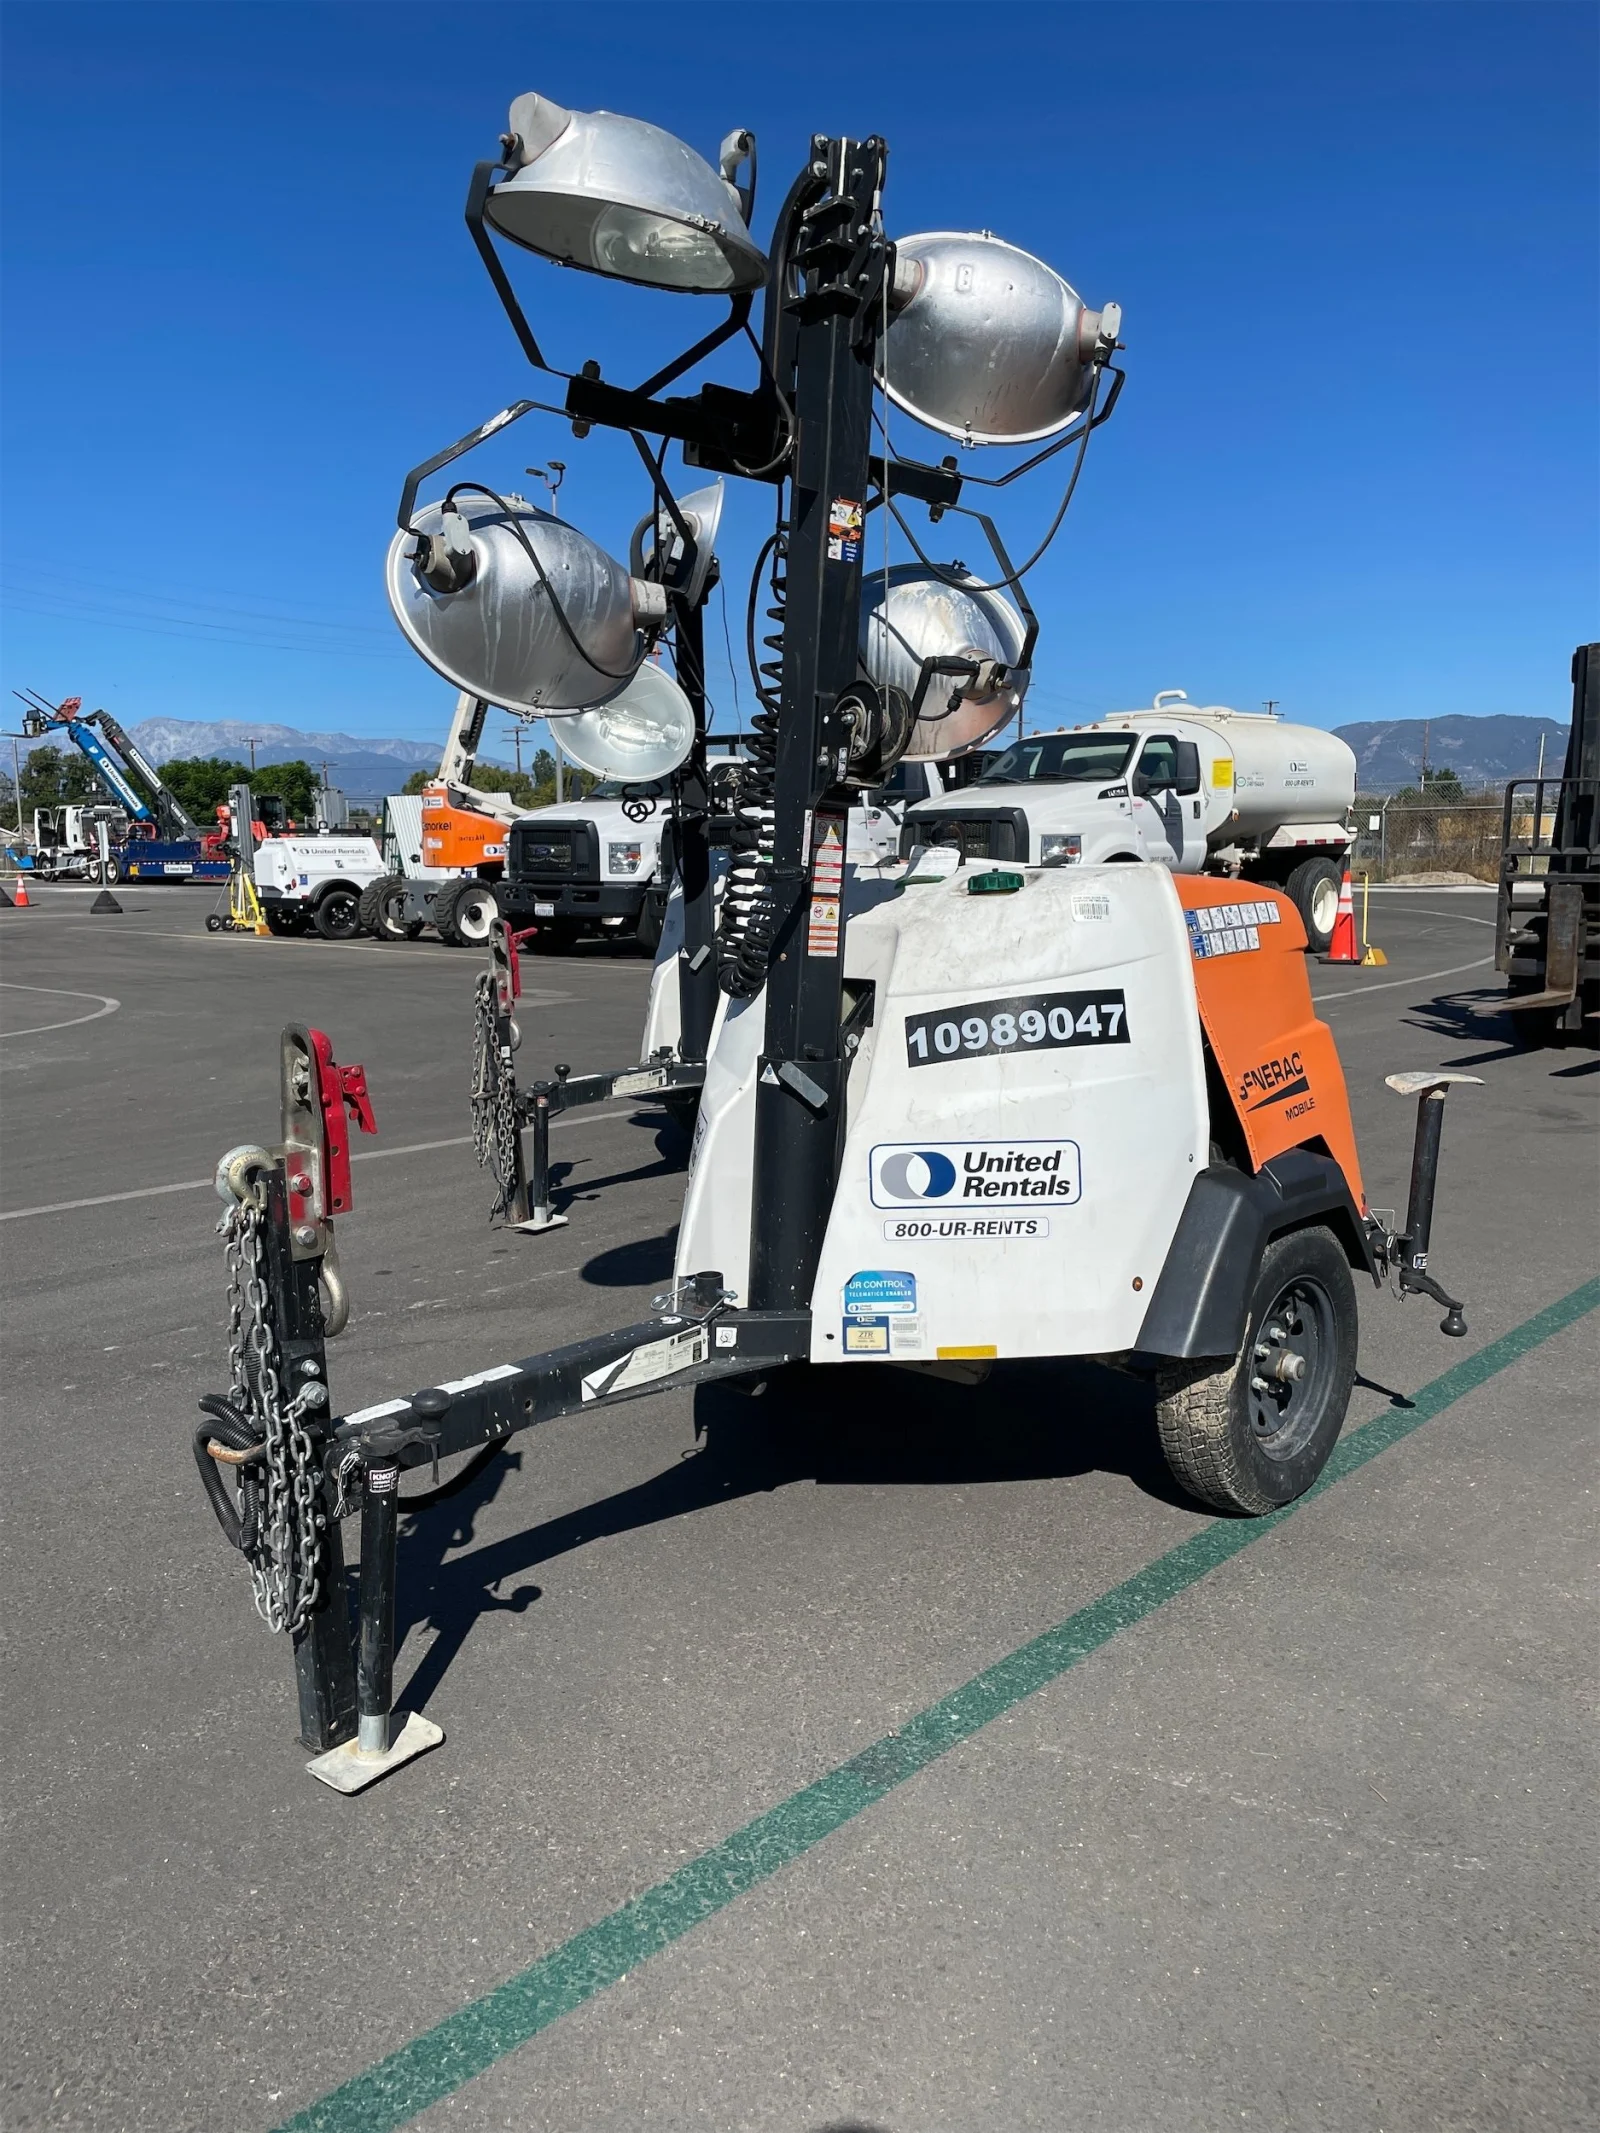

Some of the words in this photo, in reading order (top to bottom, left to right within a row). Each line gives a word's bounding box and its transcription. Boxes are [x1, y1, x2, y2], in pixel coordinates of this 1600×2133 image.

[107, 765, 125, 788] United
[121, 786, 140, 809] Rentals
[908, 1004, 1124, 1059] 10989047
[1284, 1097, 1316, 1121] MOBILE
[963, 1150, 1062, 1173] United
[963, 1174, 1071, 1198] Rentals
[895, 1220, 1038, 1238] 800-UR-RENTS
[849, 1281, 862, 1289] UR
[863, 1280, 906, 1289] CONTROL
[858, 1330, 875, 1338] ZTR
